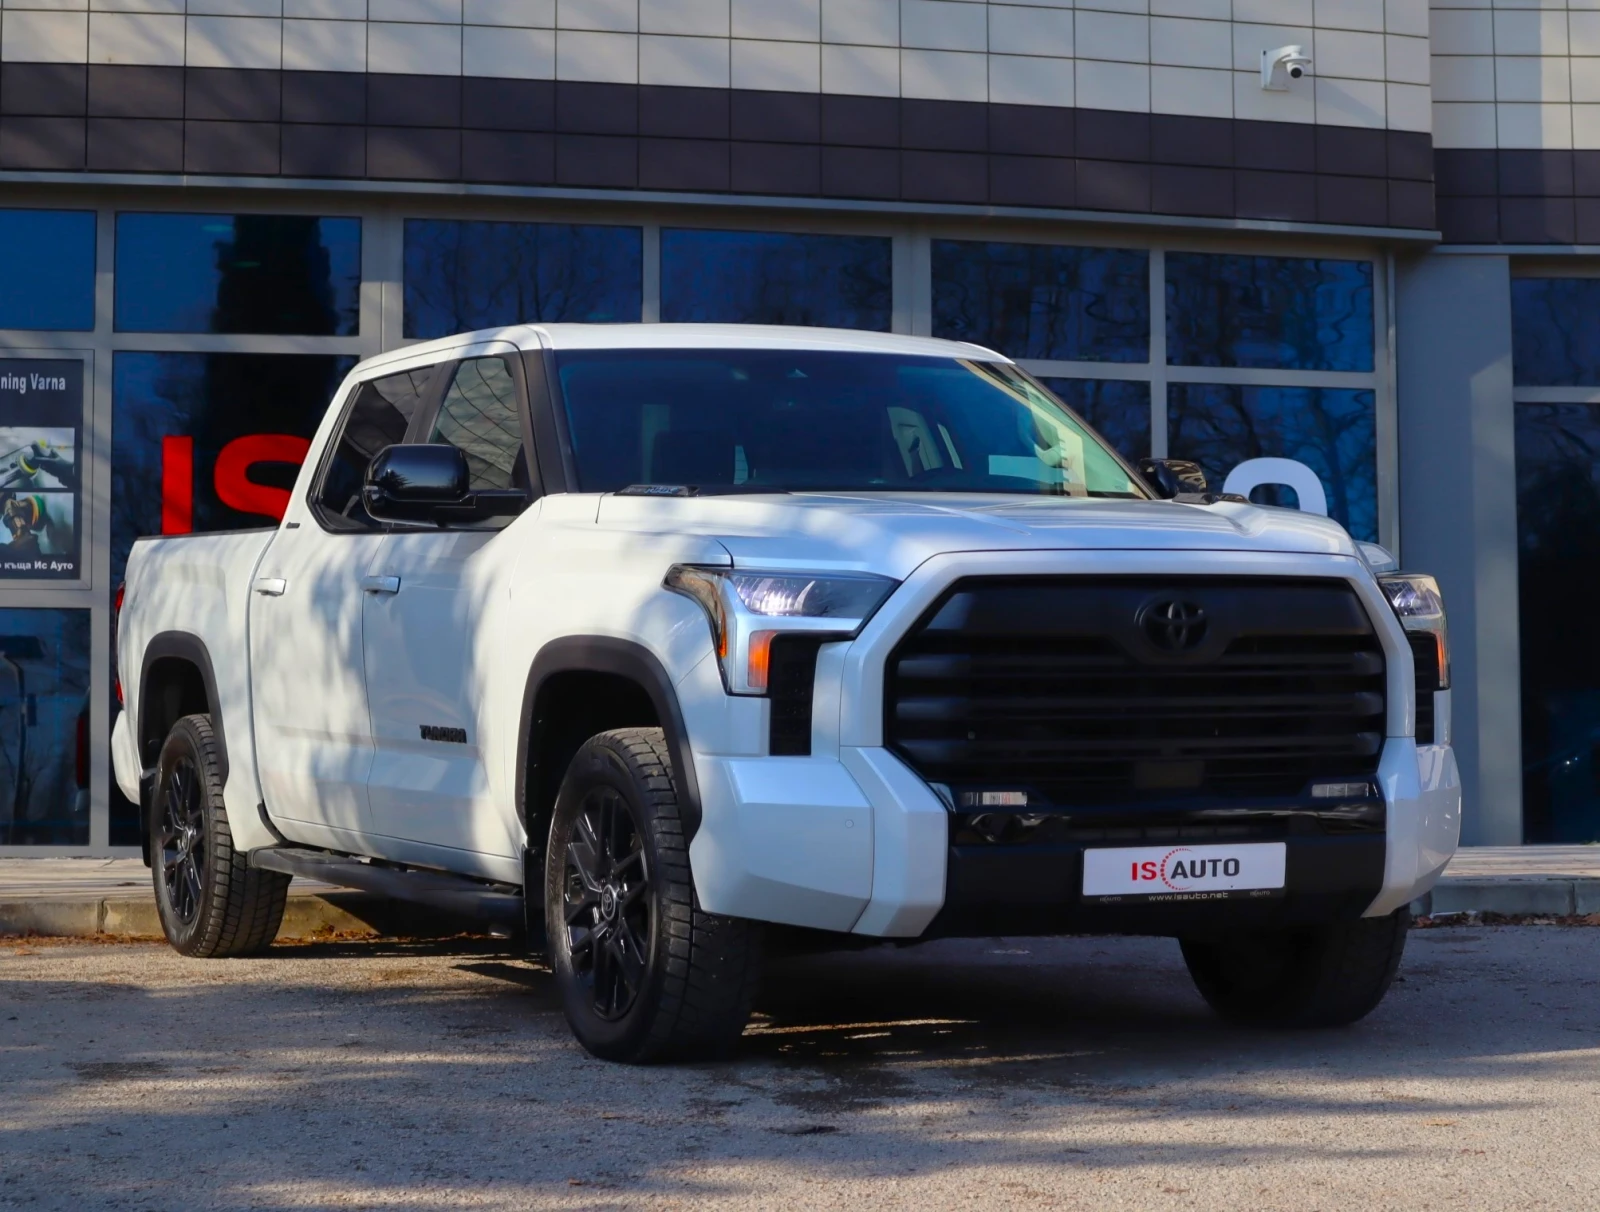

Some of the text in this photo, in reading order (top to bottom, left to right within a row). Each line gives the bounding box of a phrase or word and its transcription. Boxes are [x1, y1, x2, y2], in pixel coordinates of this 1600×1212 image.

[0, 372, 66, 394] ning Varna
[4, 562, 31, 571] къща
[34, 560, 48, 570] Ис
[50, 561, 74, 572] Ауто
[1131, 858, 1240, 881] IS AUTO
[1148, 891, 1229, 901] www.isauto.net
